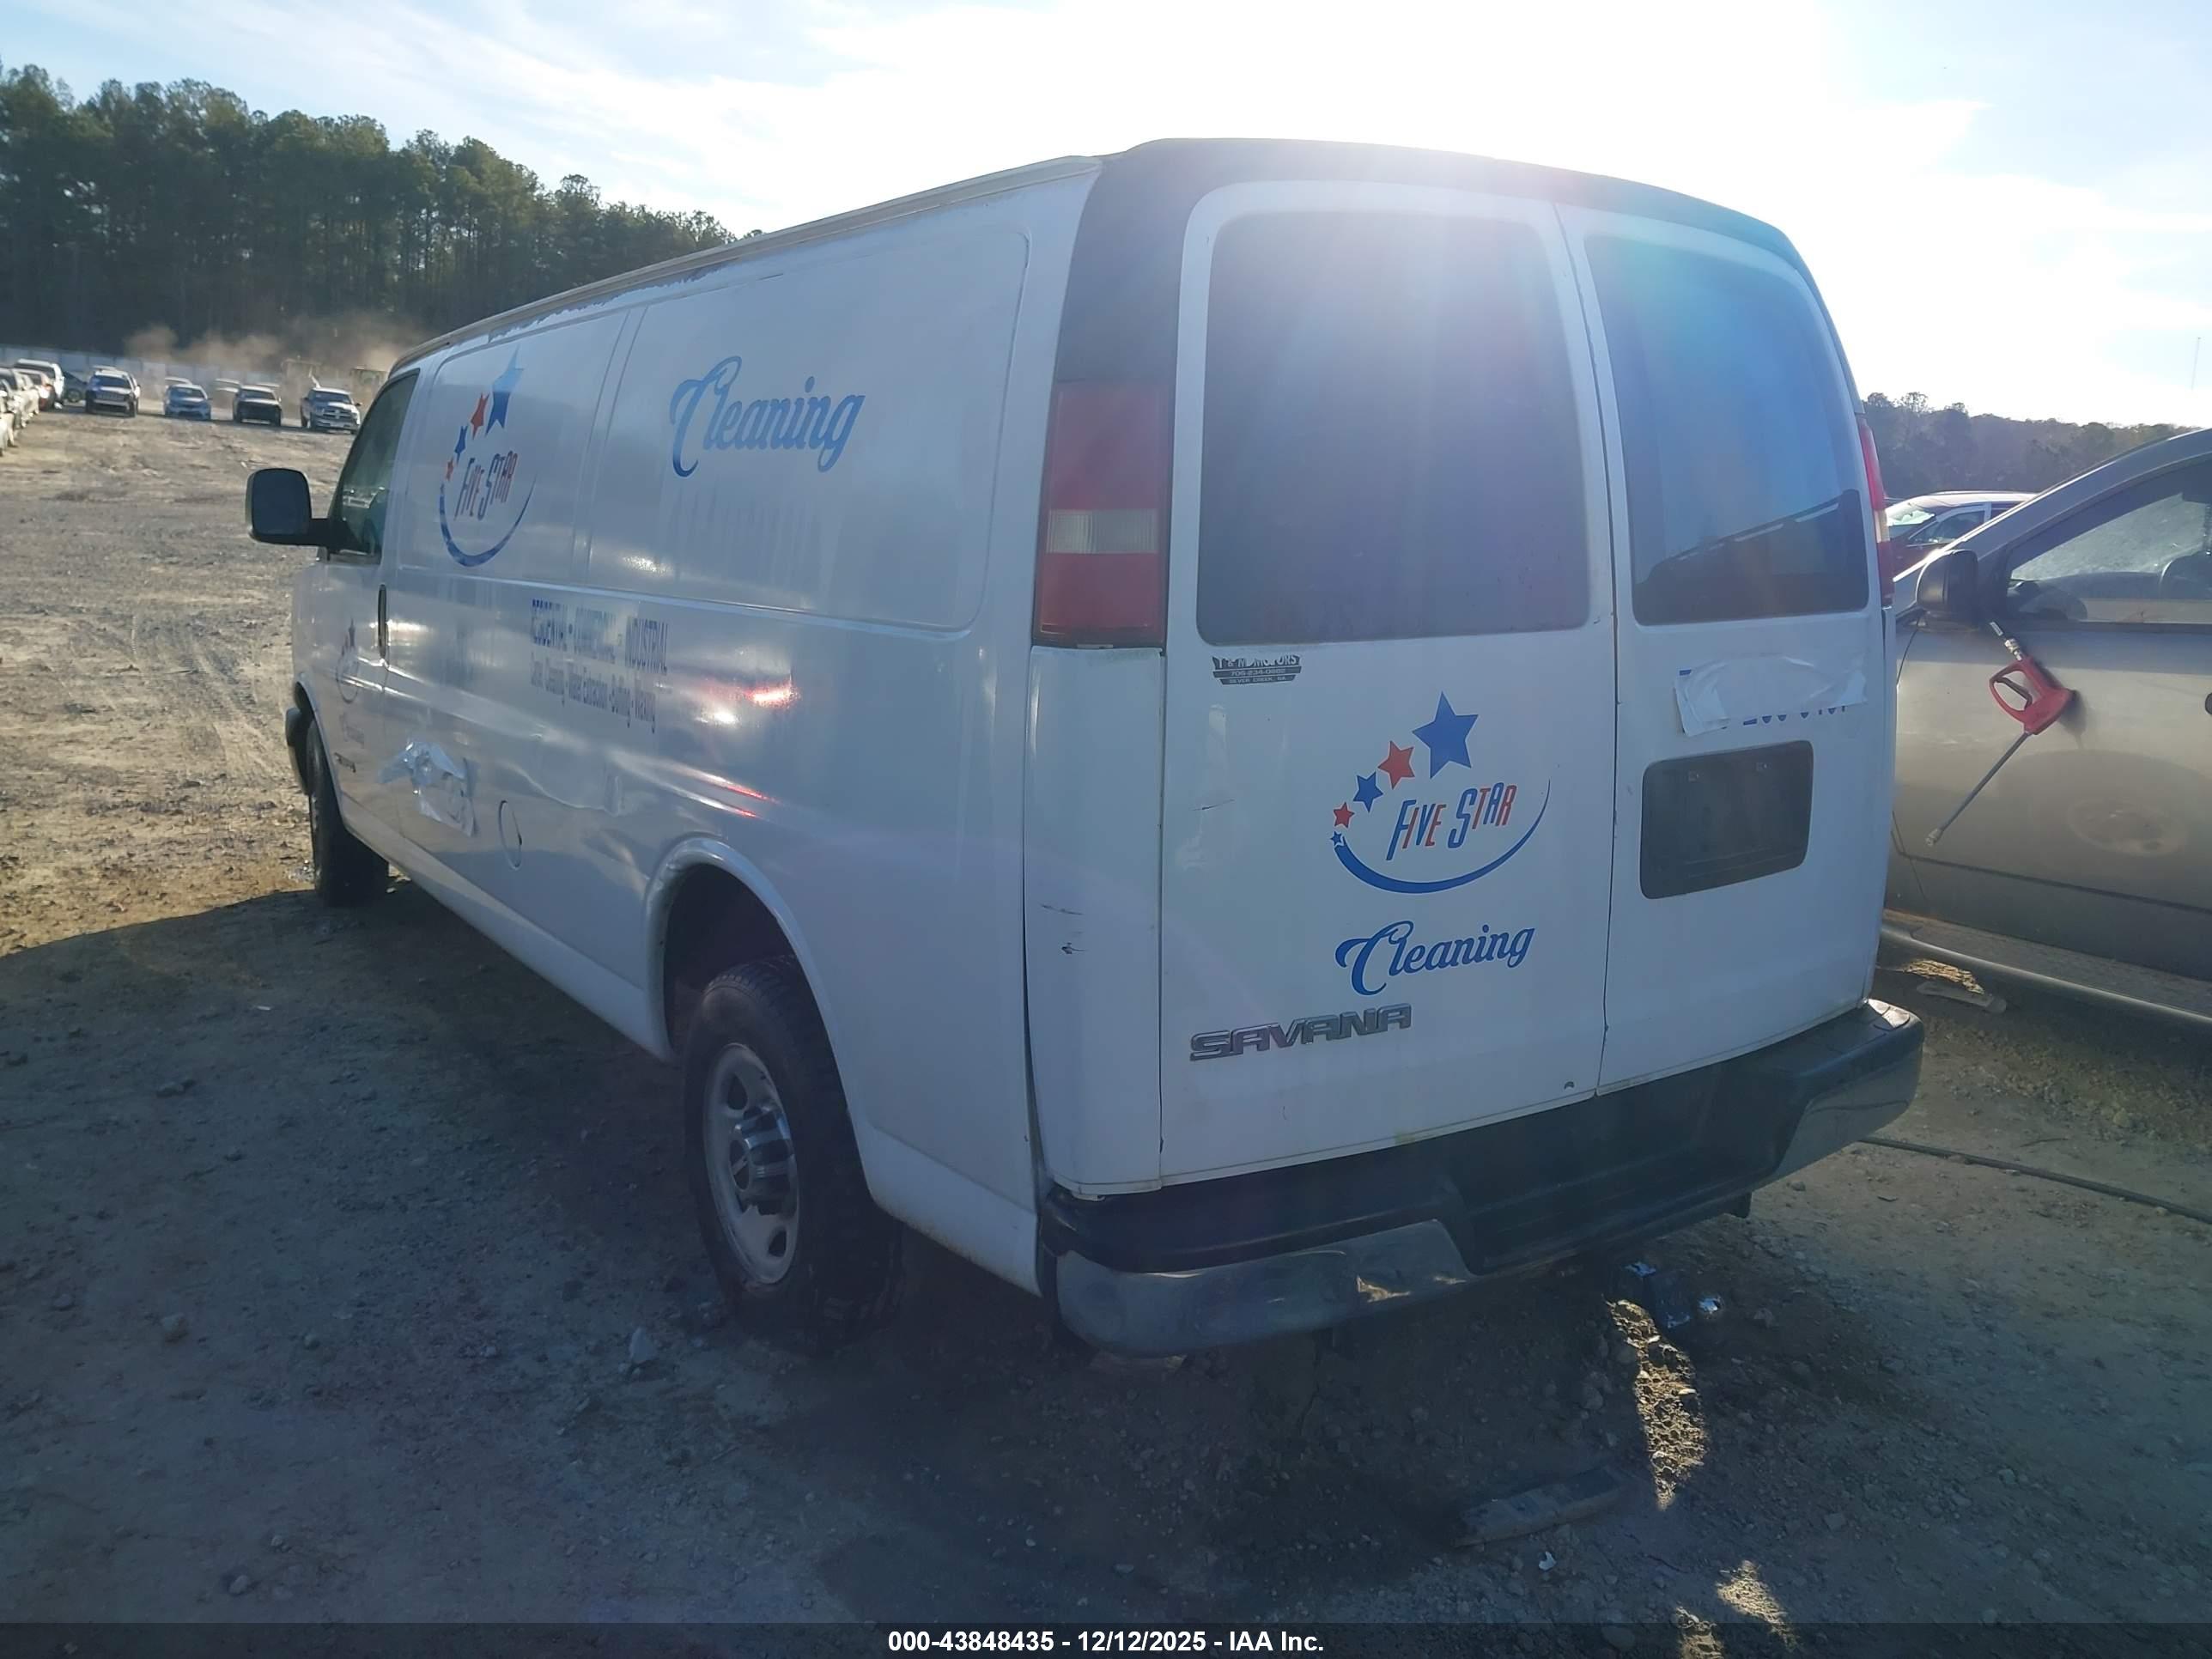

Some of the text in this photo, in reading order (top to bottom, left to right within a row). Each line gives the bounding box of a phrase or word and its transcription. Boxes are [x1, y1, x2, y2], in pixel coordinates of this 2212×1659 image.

[670, 356, 866, 477] Cleaning
[477, 451, 517, 520] STAR
[1386, 782, 1518, 861] FIVE STAR
[1334, 920, 1535, 996] Cleaning
[1189, 1003, 1413, 1061] SAVANA
